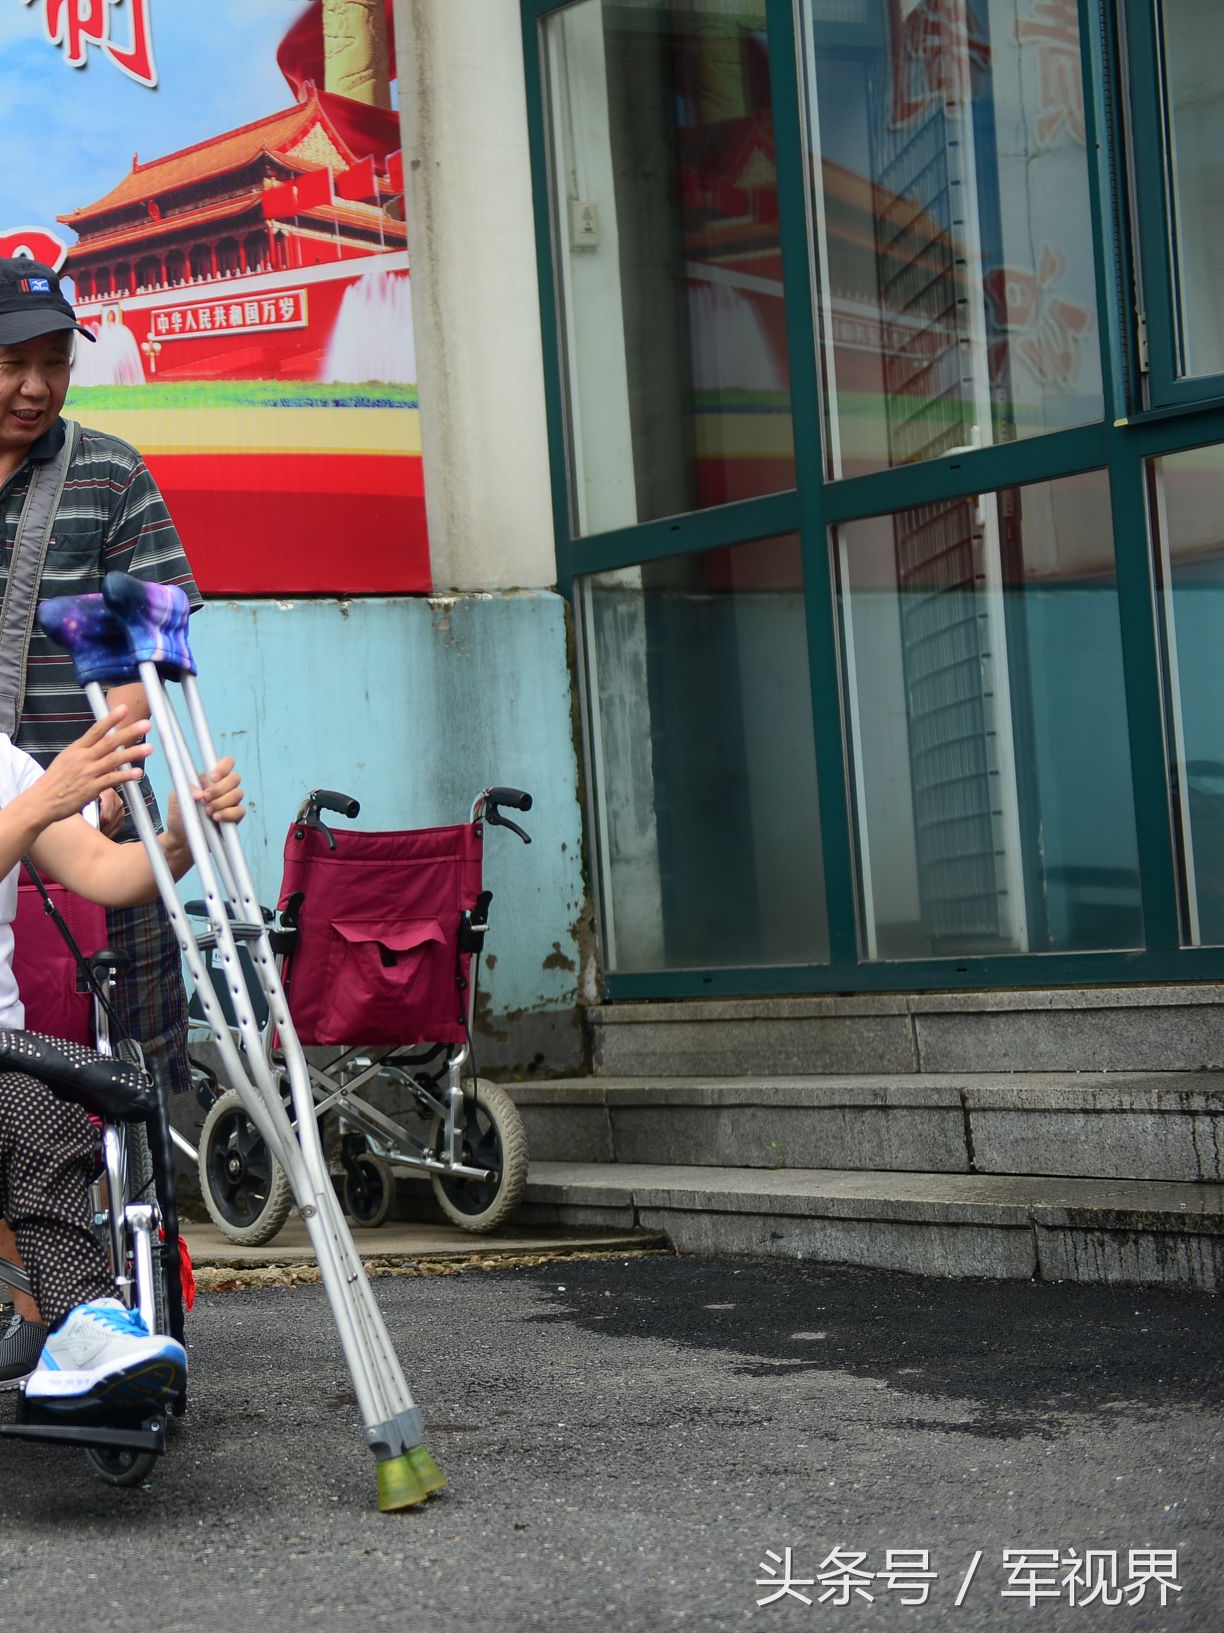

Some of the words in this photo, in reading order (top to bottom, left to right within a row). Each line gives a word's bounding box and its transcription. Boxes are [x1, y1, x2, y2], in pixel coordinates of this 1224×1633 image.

[156, 296, 296, 334] 中华人民共和国万岁
